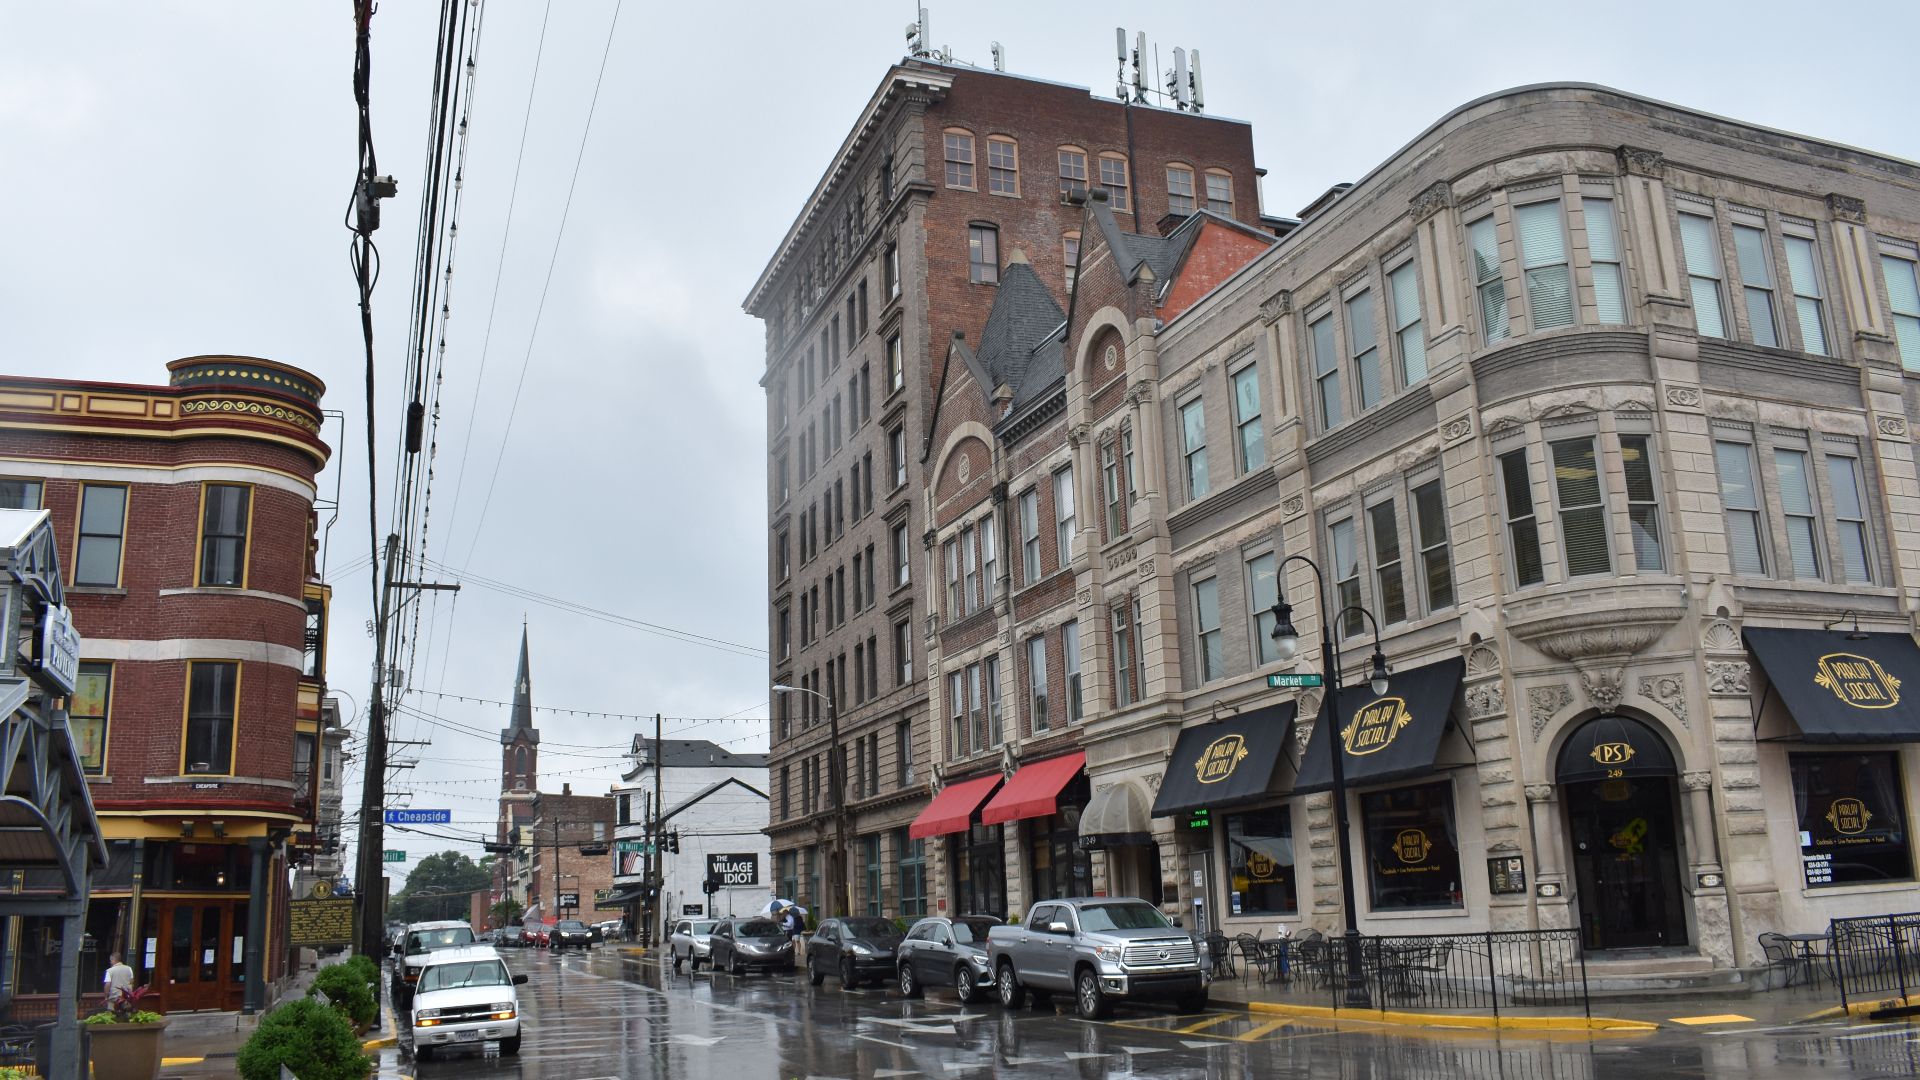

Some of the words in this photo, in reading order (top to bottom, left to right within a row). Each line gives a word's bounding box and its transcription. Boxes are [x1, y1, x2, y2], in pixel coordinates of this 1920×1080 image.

[1830, 662, 1872, 680] PARLAY
[1273, 675, 1303, 686] Market
[1844, 682, 1888, 699] SOCIAL
[1361, 704, 1395, 728] PARLAY
[1355, 725, 1387, 748] SOCIAL
[1211, 741, 1237, 760] PARLAY
[1604, 745, 1622, 761] PS
[1205, 759, 1230, 777] SOCIAL
[1607, 769, 1623, 778] 249
[1838, 804, 1858, 815] PARLAY
[397, 811, 447, 823] Cheapside
[1840, 817, 1861, 829] SOCIAL
[618, 842, 624, 851] N
[625, 842, 638, 851] Mill
[712, 862, 753, 873] VILLAGE
[724, 872, 753, 884] IDIOT
